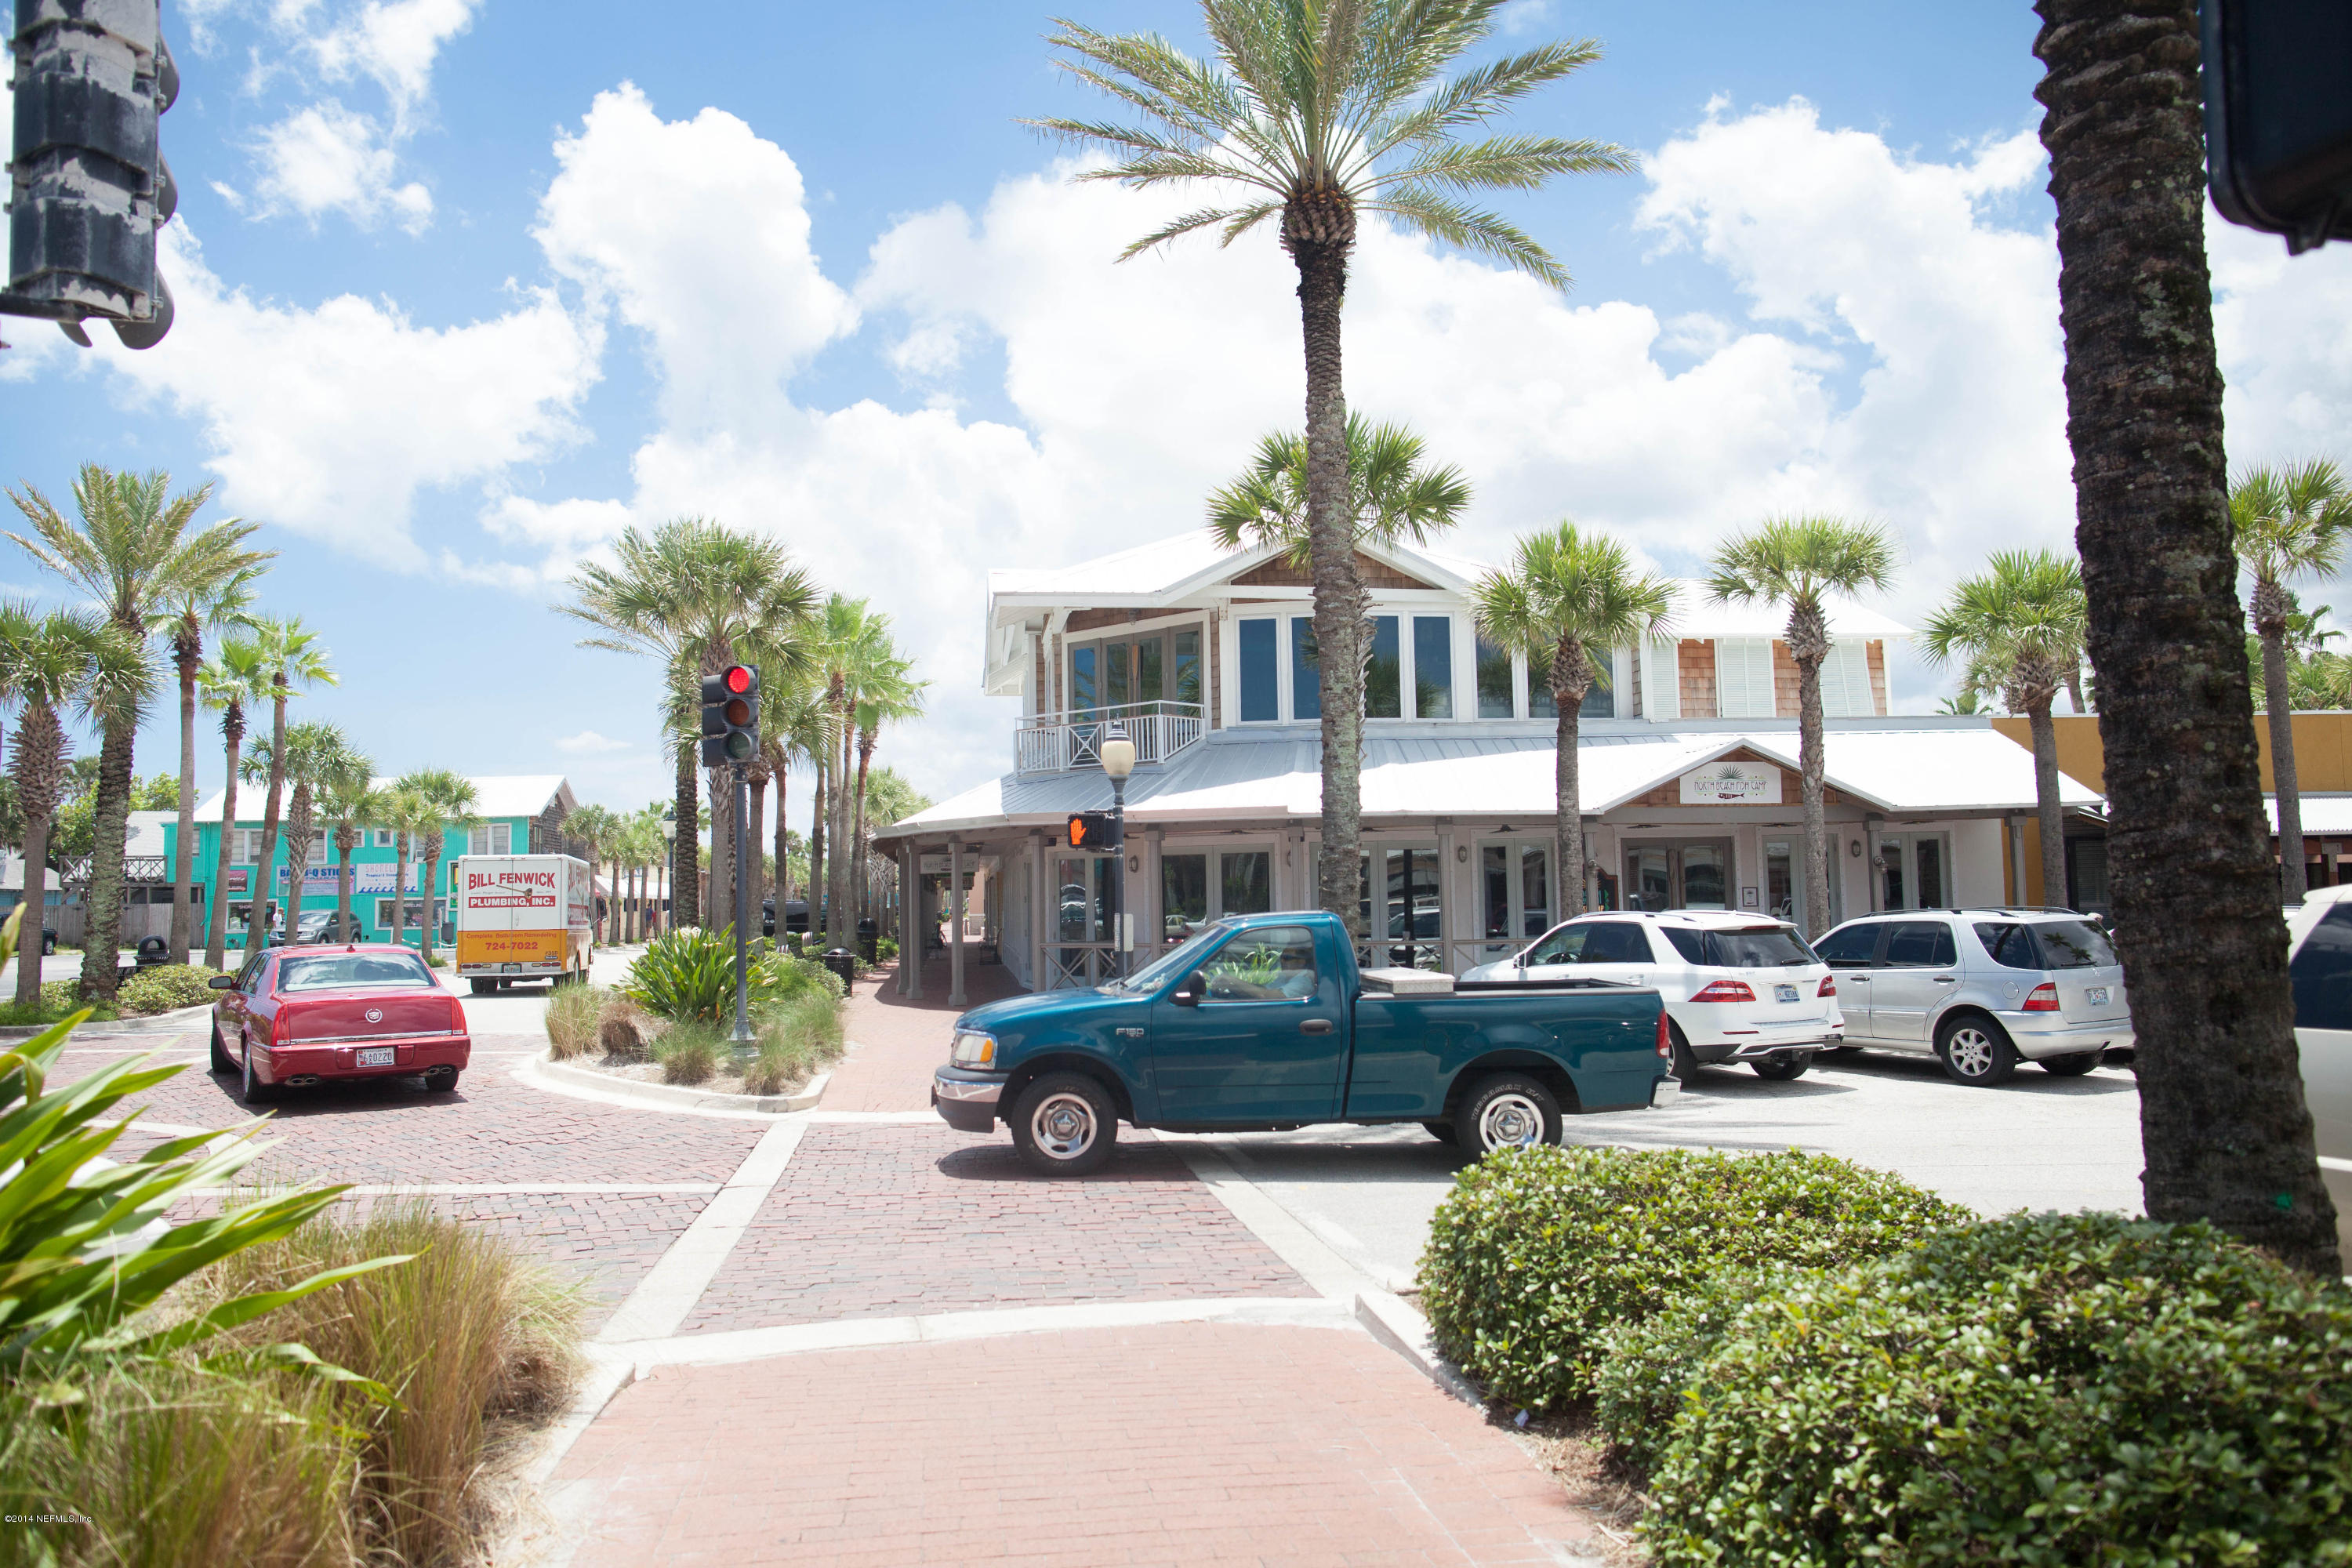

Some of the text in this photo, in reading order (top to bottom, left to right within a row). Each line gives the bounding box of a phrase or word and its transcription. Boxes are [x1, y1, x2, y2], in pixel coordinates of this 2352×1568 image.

[1694, 781, 1767, 791] NORTH BEACH FISH CAMP
[468, 873, 495, 890] BILL
[499, 872, 556, 889] FENWICK
[470, 897, 554, 907] PLUMBING, INC.
[485, 942, 538, 950] 724-7022
